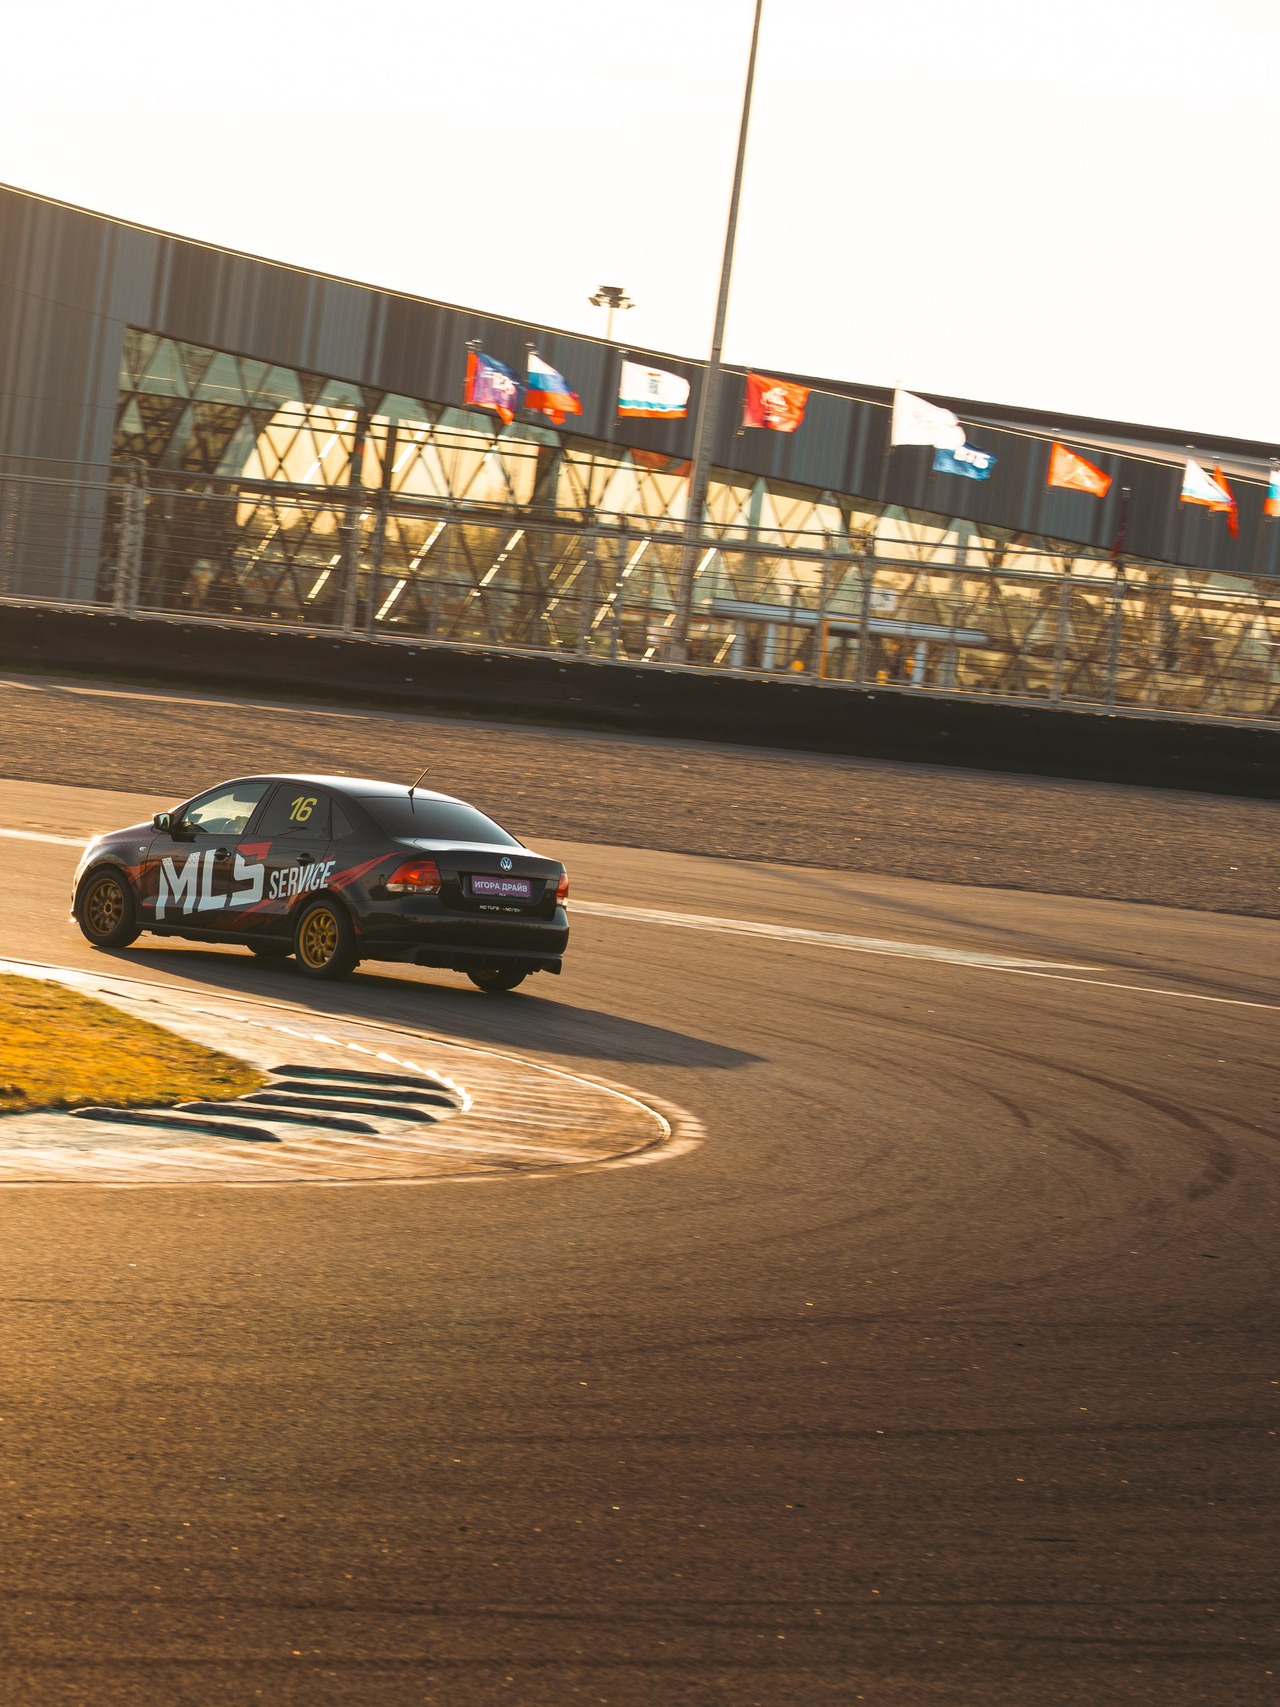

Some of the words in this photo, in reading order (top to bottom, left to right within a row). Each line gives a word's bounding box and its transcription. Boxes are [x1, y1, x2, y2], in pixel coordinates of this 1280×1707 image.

[289, 796, 317, 822] 16
[155, 842, 272, 921] MLS
[268, 860, 336, 900] SERVICE
[474, 880, 500, 890] ИГОРА
[501, 882, 528, 893] ДРАЙВ
